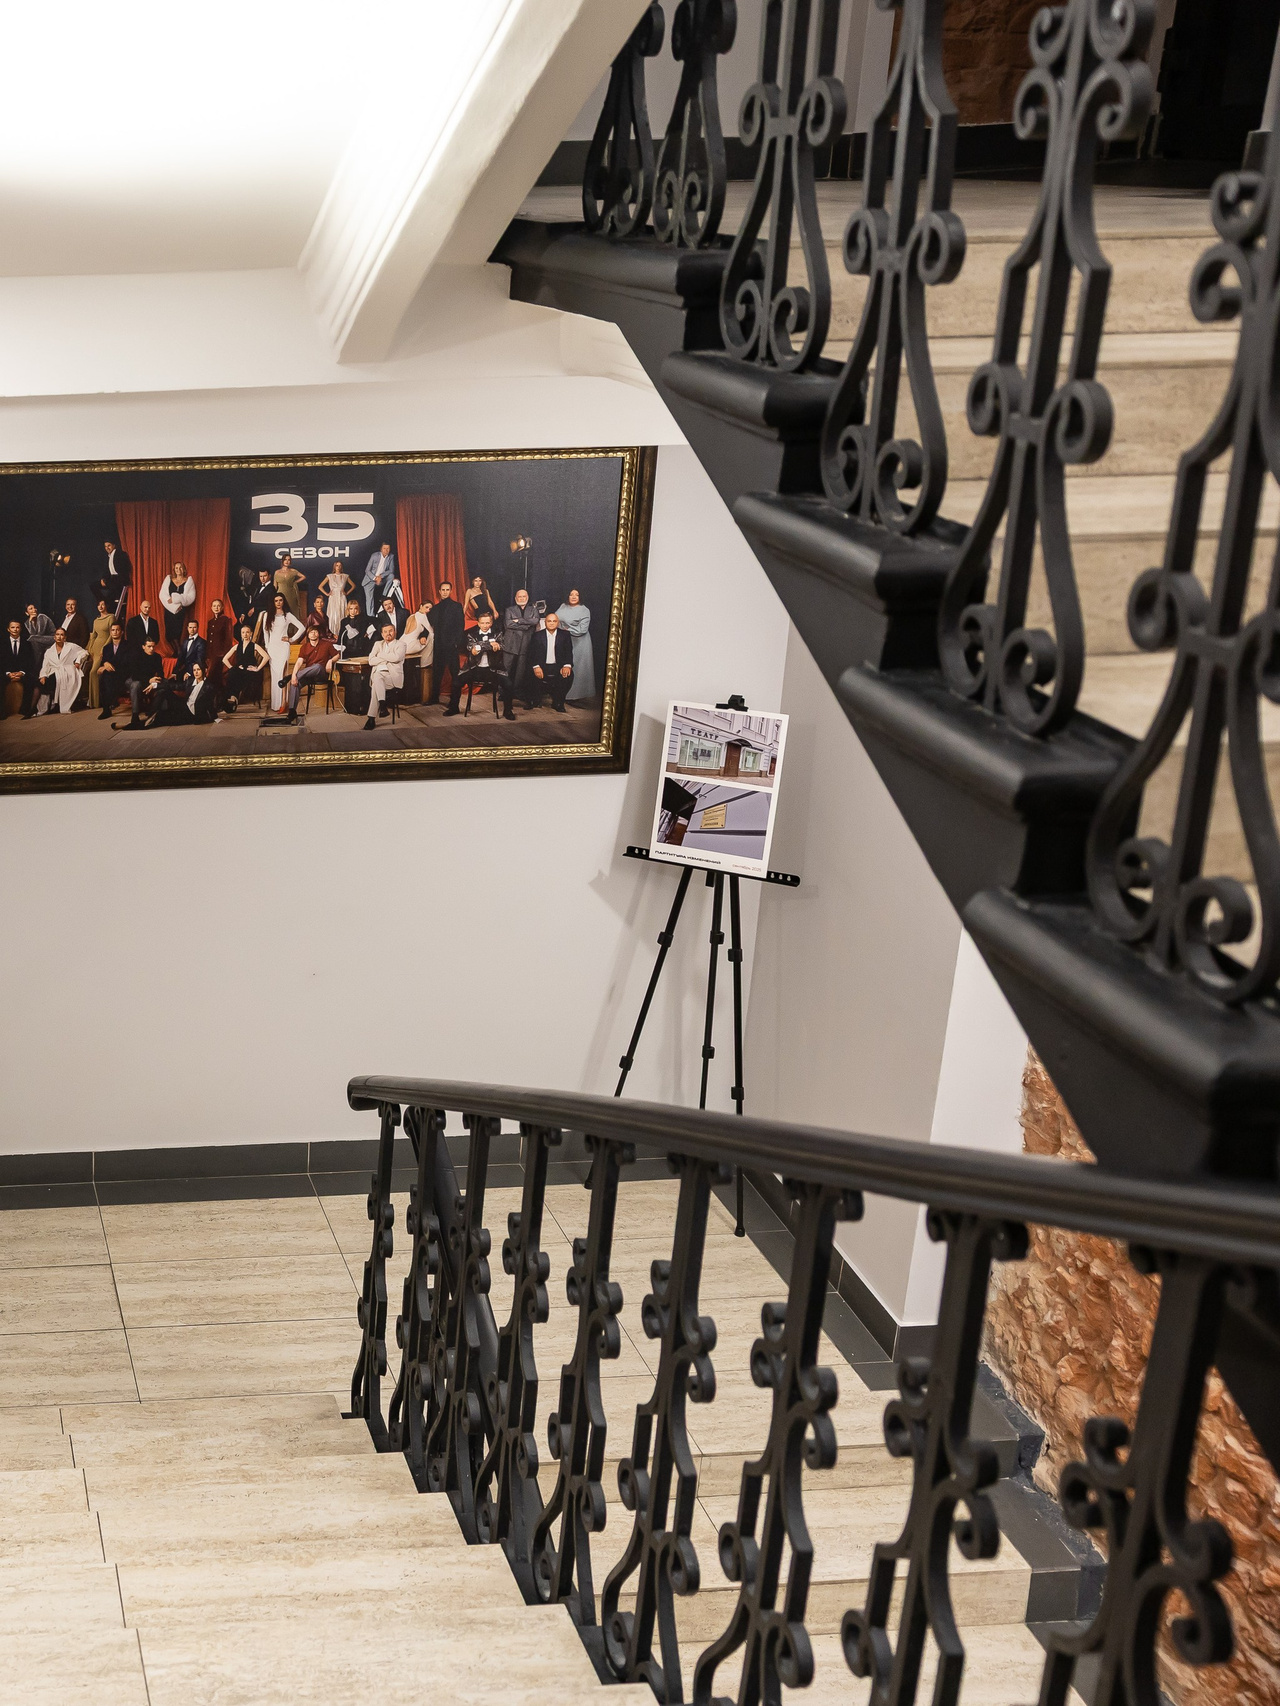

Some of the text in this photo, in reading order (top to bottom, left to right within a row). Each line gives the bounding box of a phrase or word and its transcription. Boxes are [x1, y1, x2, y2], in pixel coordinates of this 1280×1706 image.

[250, 492, 376, 544] 35
[274, 546, 350, 559] СЕЗОН
[690, 728, 719, 740] ТЕАТР
